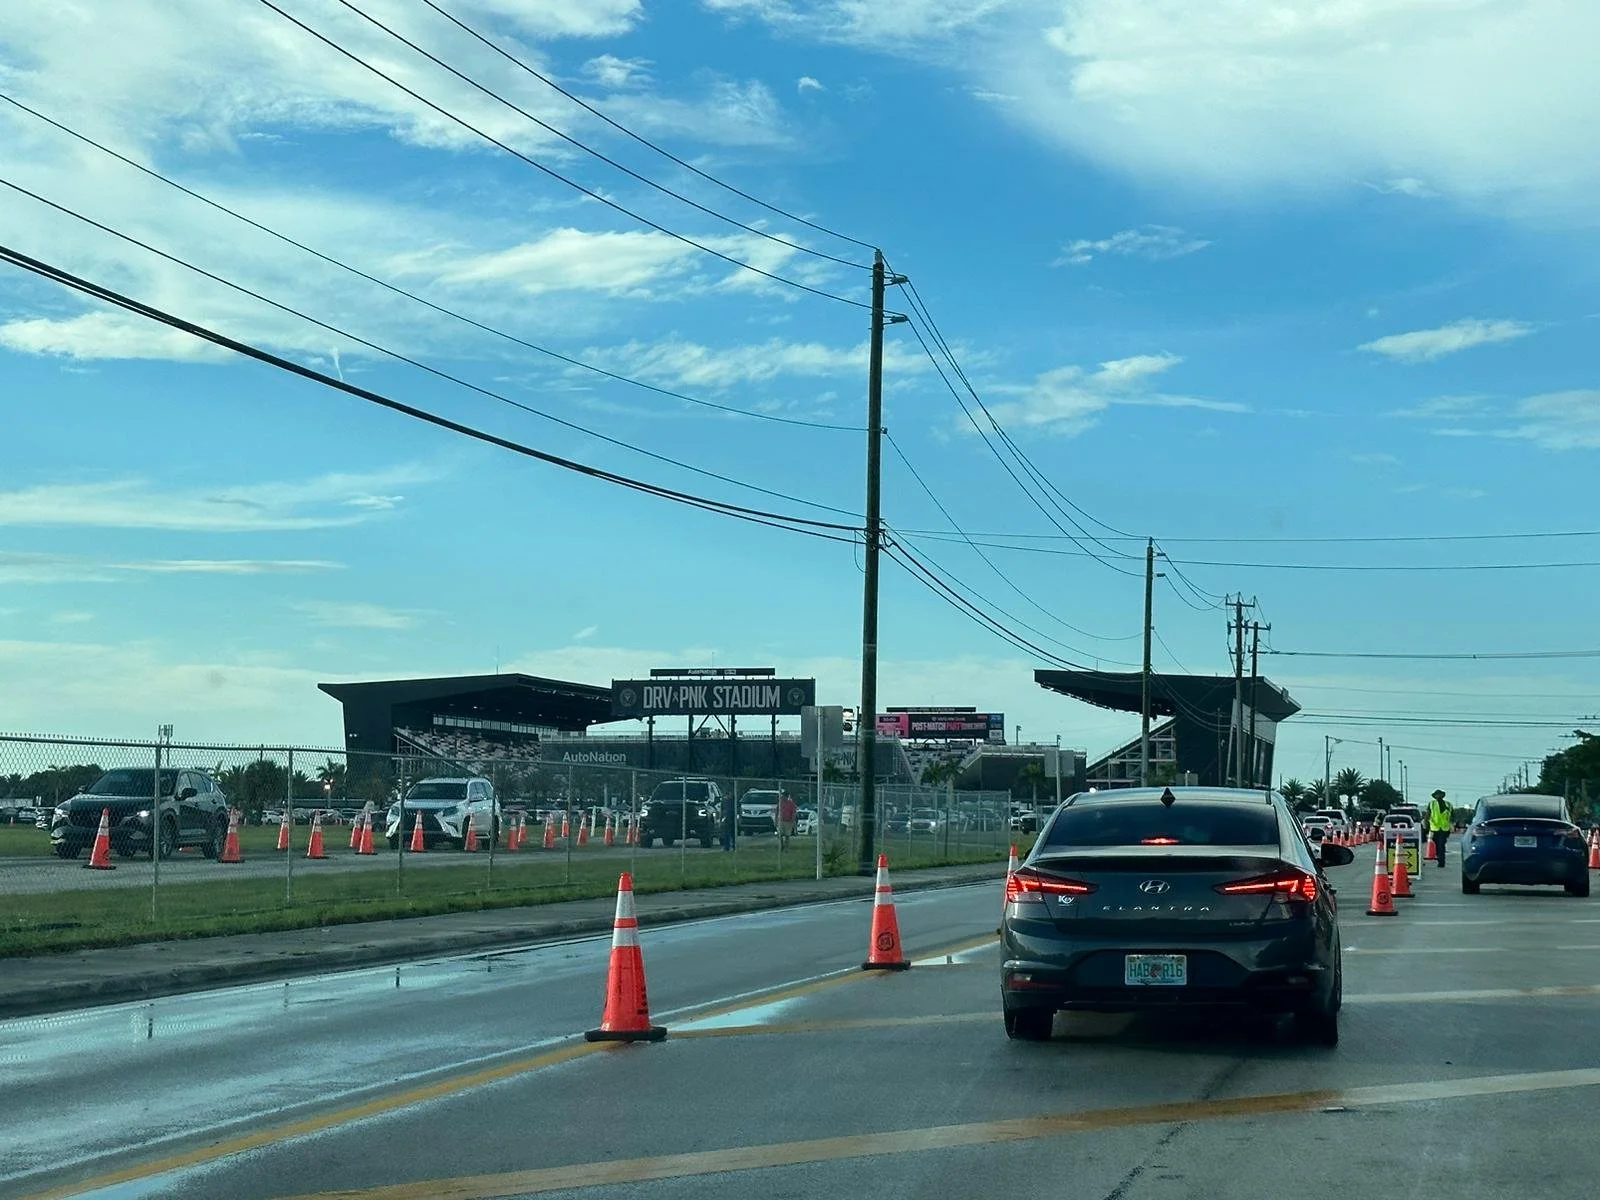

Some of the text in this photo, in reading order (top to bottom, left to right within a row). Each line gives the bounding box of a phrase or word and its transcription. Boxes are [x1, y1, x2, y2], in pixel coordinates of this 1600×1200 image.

[643, 685, 780, 709] DRV PNK STADIUM
[562, 752, 627, 763] AutoNation
[1162, 963, 1183, 978] R16
